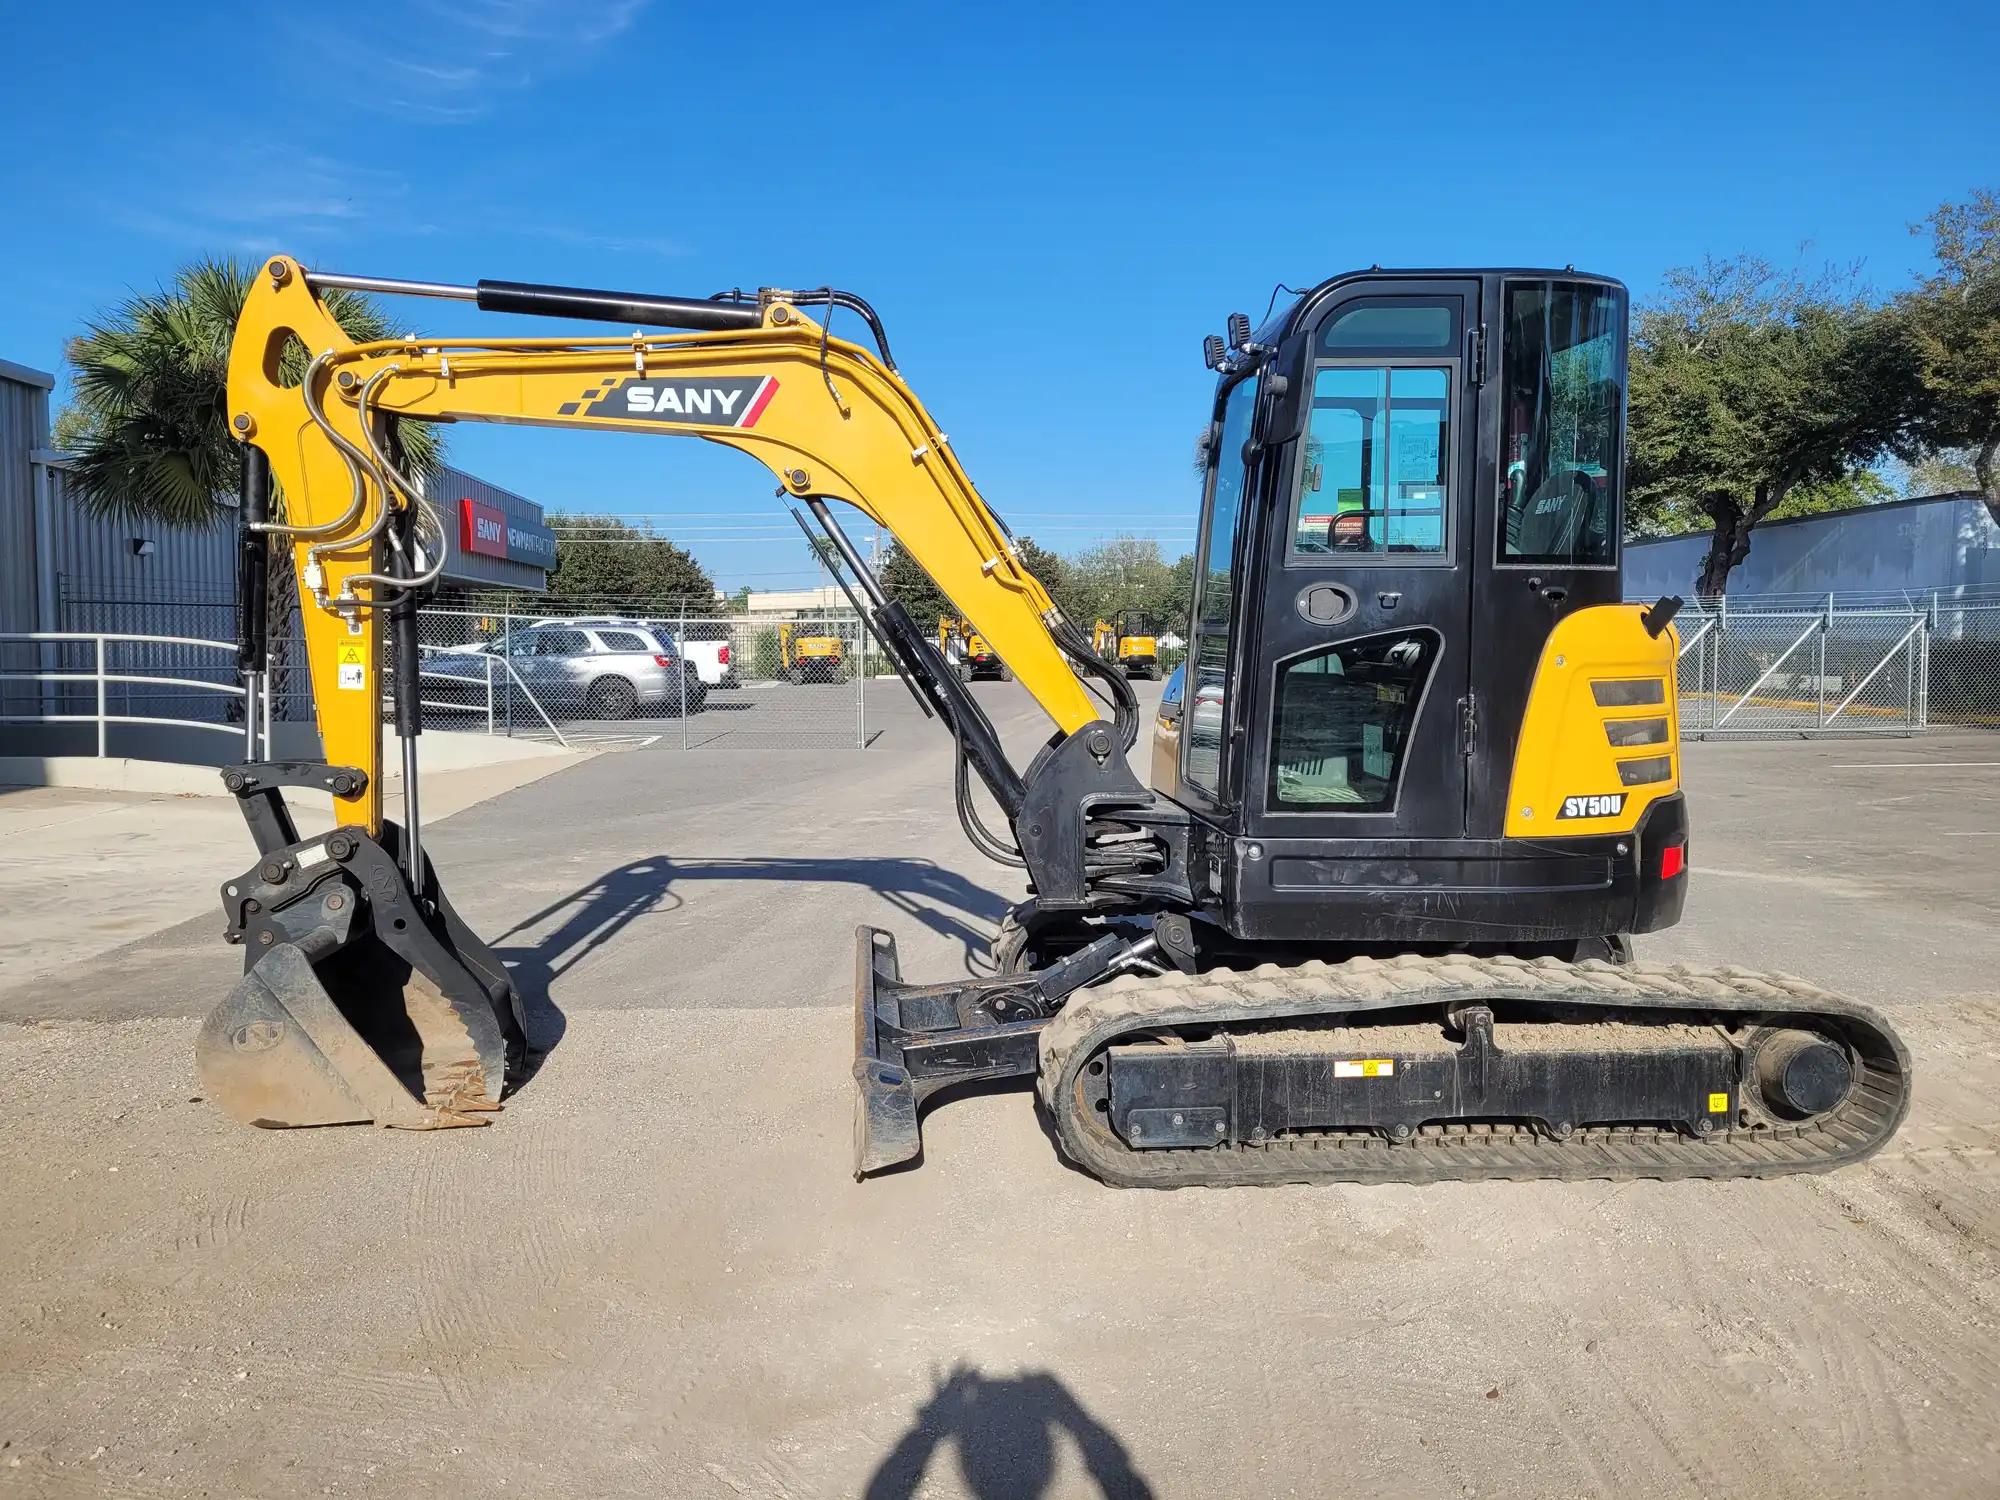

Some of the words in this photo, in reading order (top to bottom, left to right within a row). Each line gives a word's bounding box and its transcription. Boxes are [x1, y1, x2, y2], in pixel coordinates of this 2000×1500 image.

[626, 386, 743, 415] SANY
[1535, 494, 1567, 515] SANY
[477, 517, 501, 543] SANY
[1565, 795, 1621, 817] SY50U
